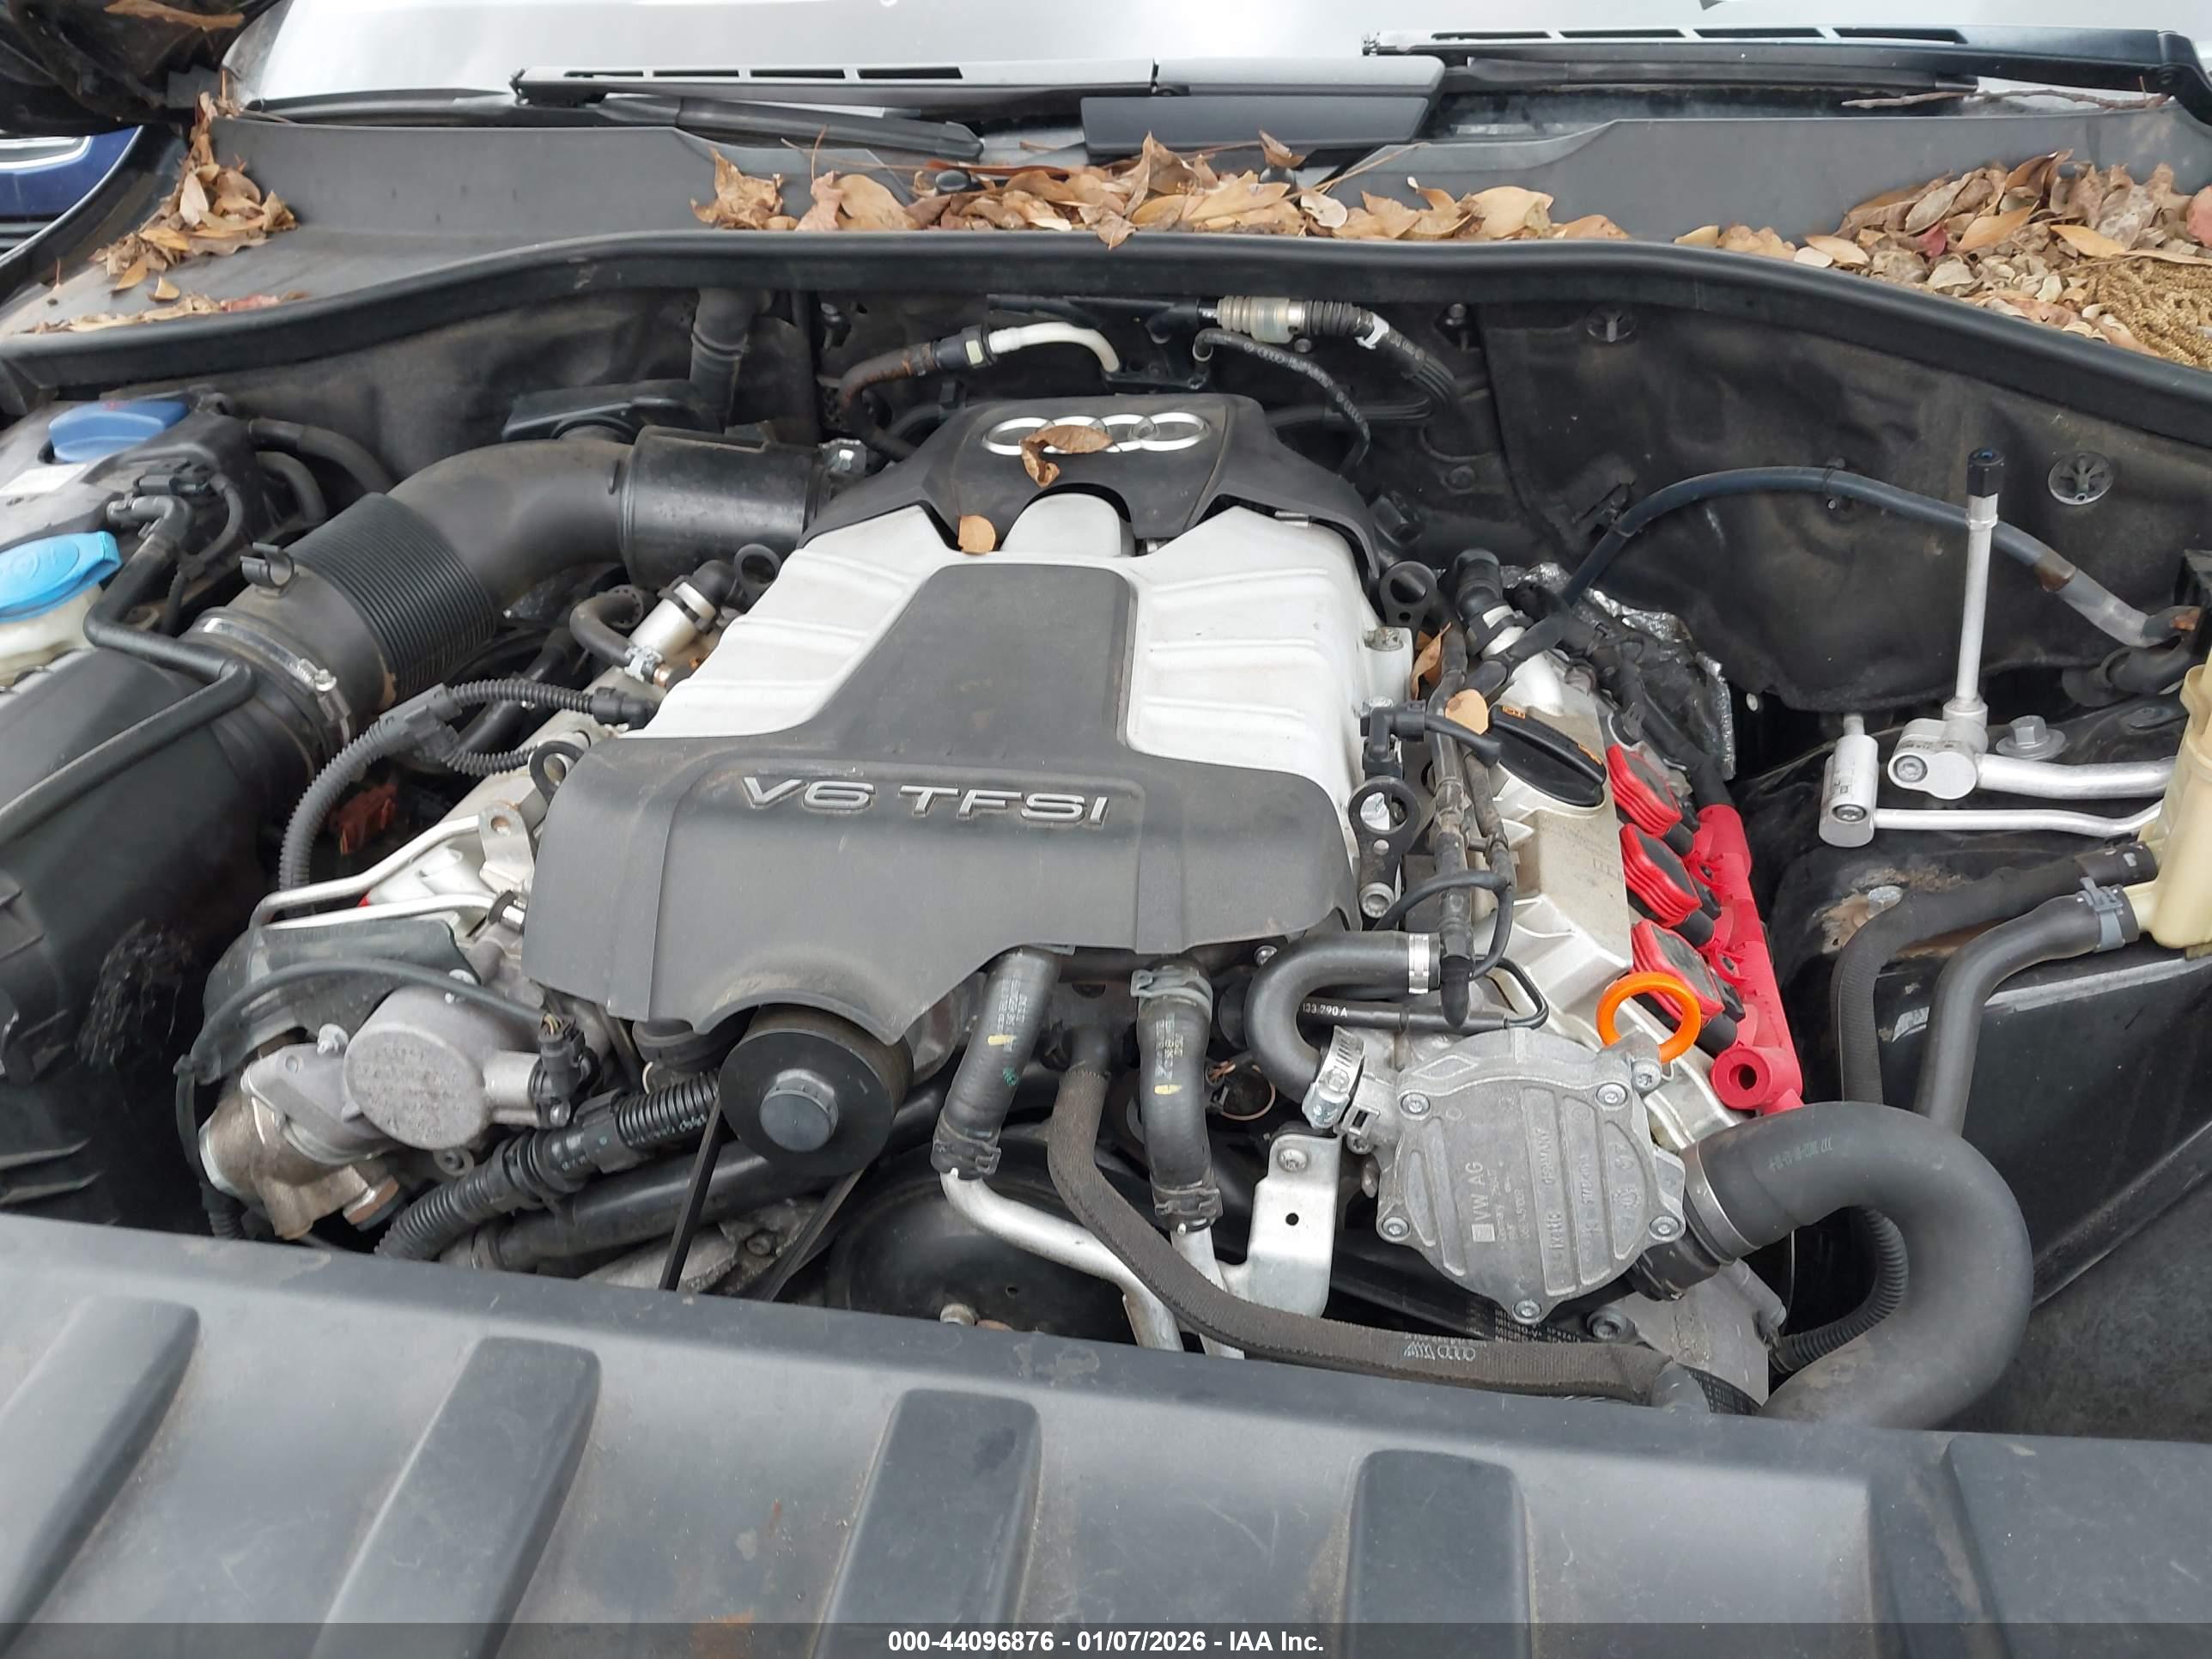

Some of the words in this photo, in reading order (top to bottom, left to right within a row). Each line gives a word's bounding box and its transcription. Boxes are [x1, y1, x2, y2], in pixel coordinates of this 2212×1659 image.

[743, 776, 876, 811] V6
[899, 785, 1108, 824] TFSI
[1320, 1004, 1339, 1017] 790
[1340, 1006, 1348, 1018] A
[1465, 1161, 1486, 1186] AG
[1470, 1194, 1492, 1221] VW
